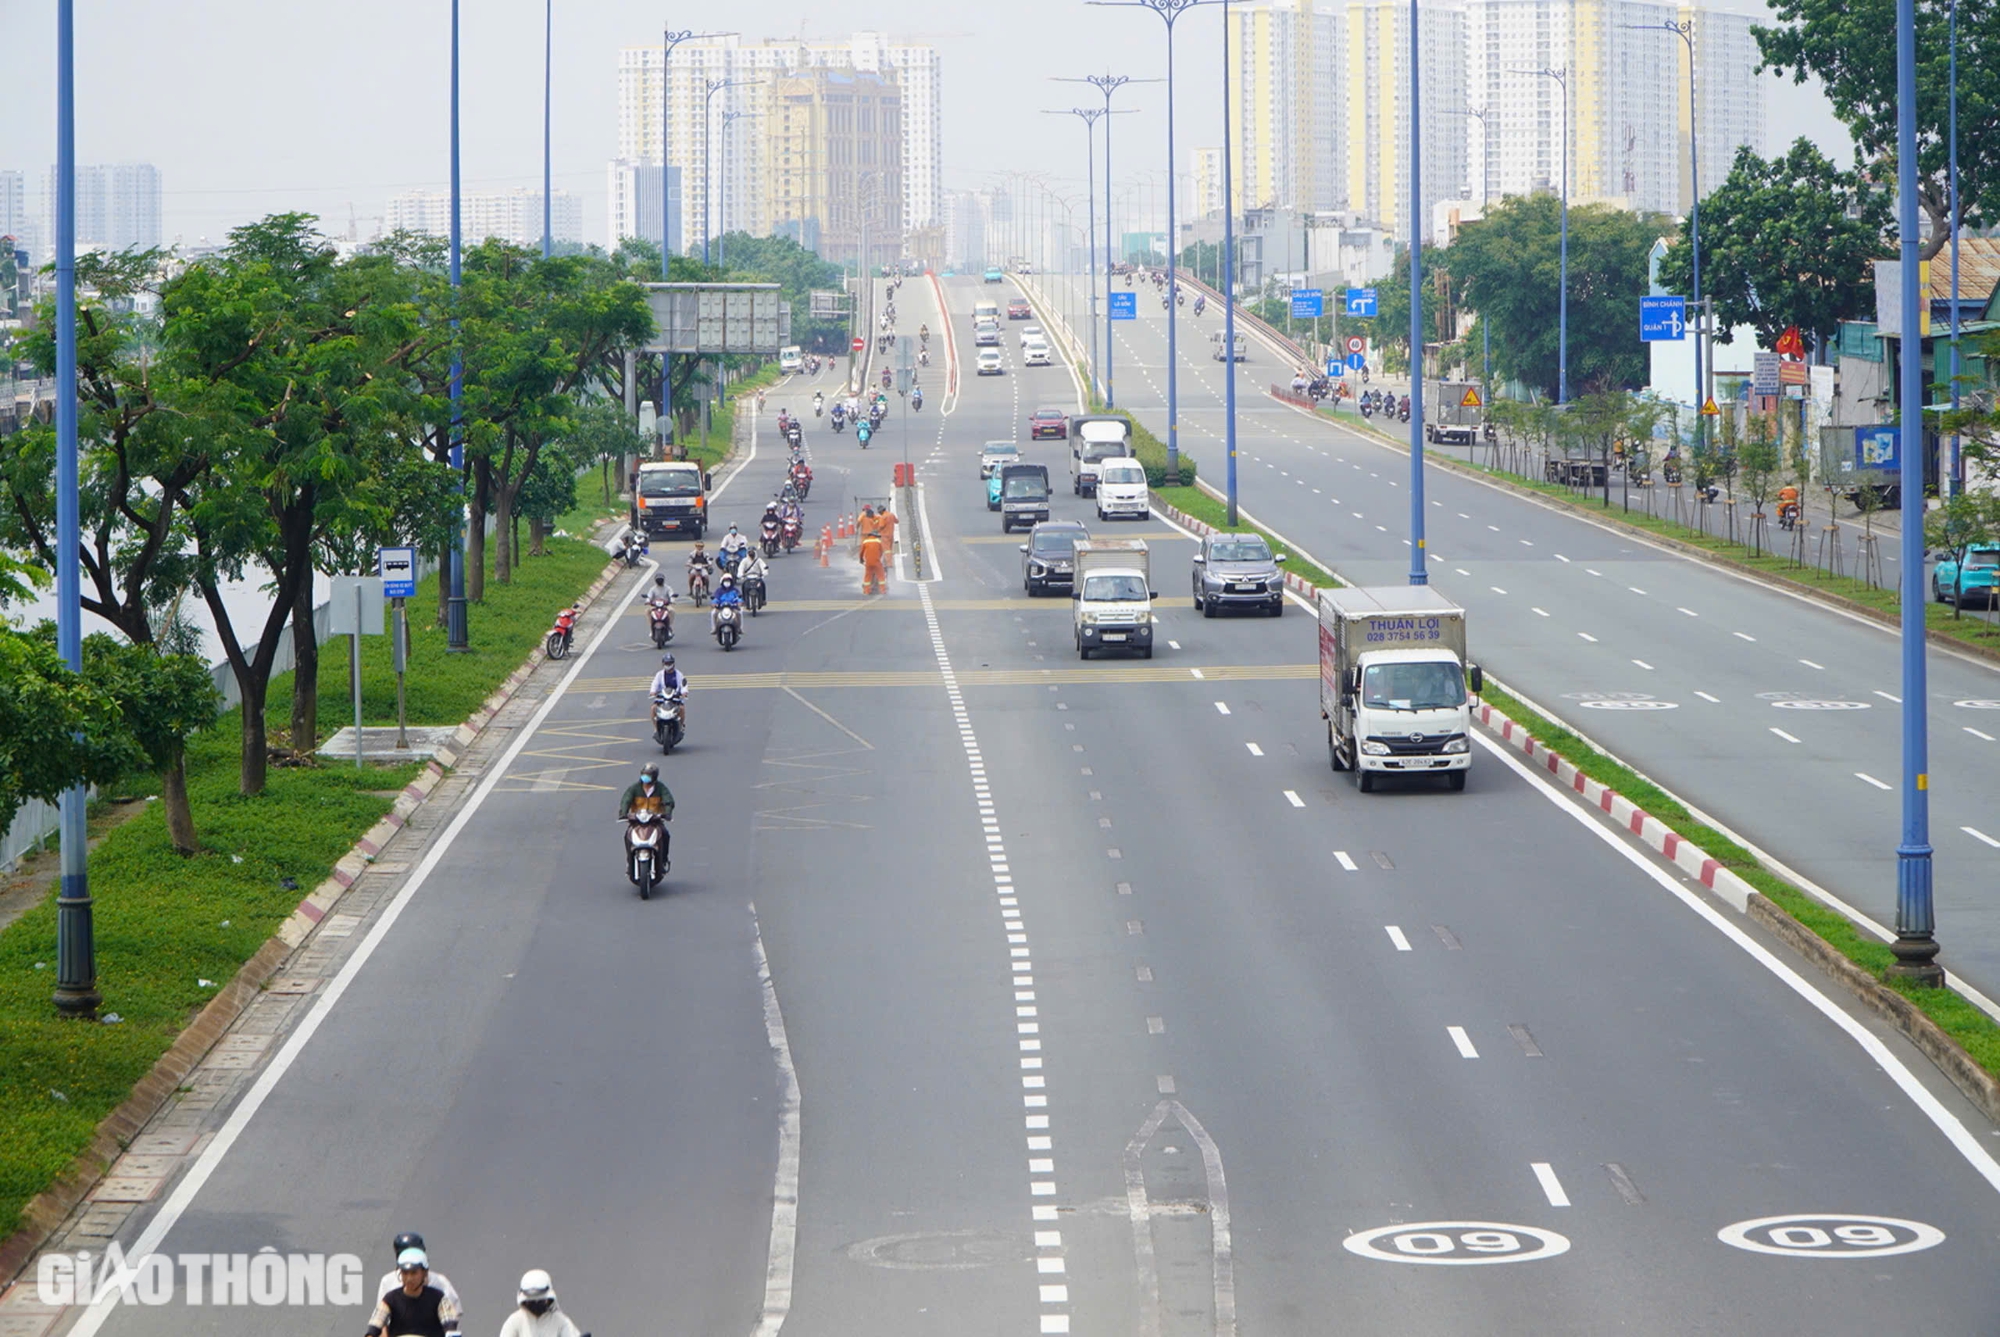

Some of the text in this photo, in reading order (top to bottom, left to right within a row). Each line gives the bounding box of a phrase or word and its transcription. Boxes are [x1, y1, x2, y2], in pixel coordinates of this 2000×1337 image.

[1643, 299, 1683, 308] BÌNH CHÁNH
[1369, 617, 1439, 631] THUẬN LỢI
[1367, 630, 1440, 642] 028 3754 56 39
